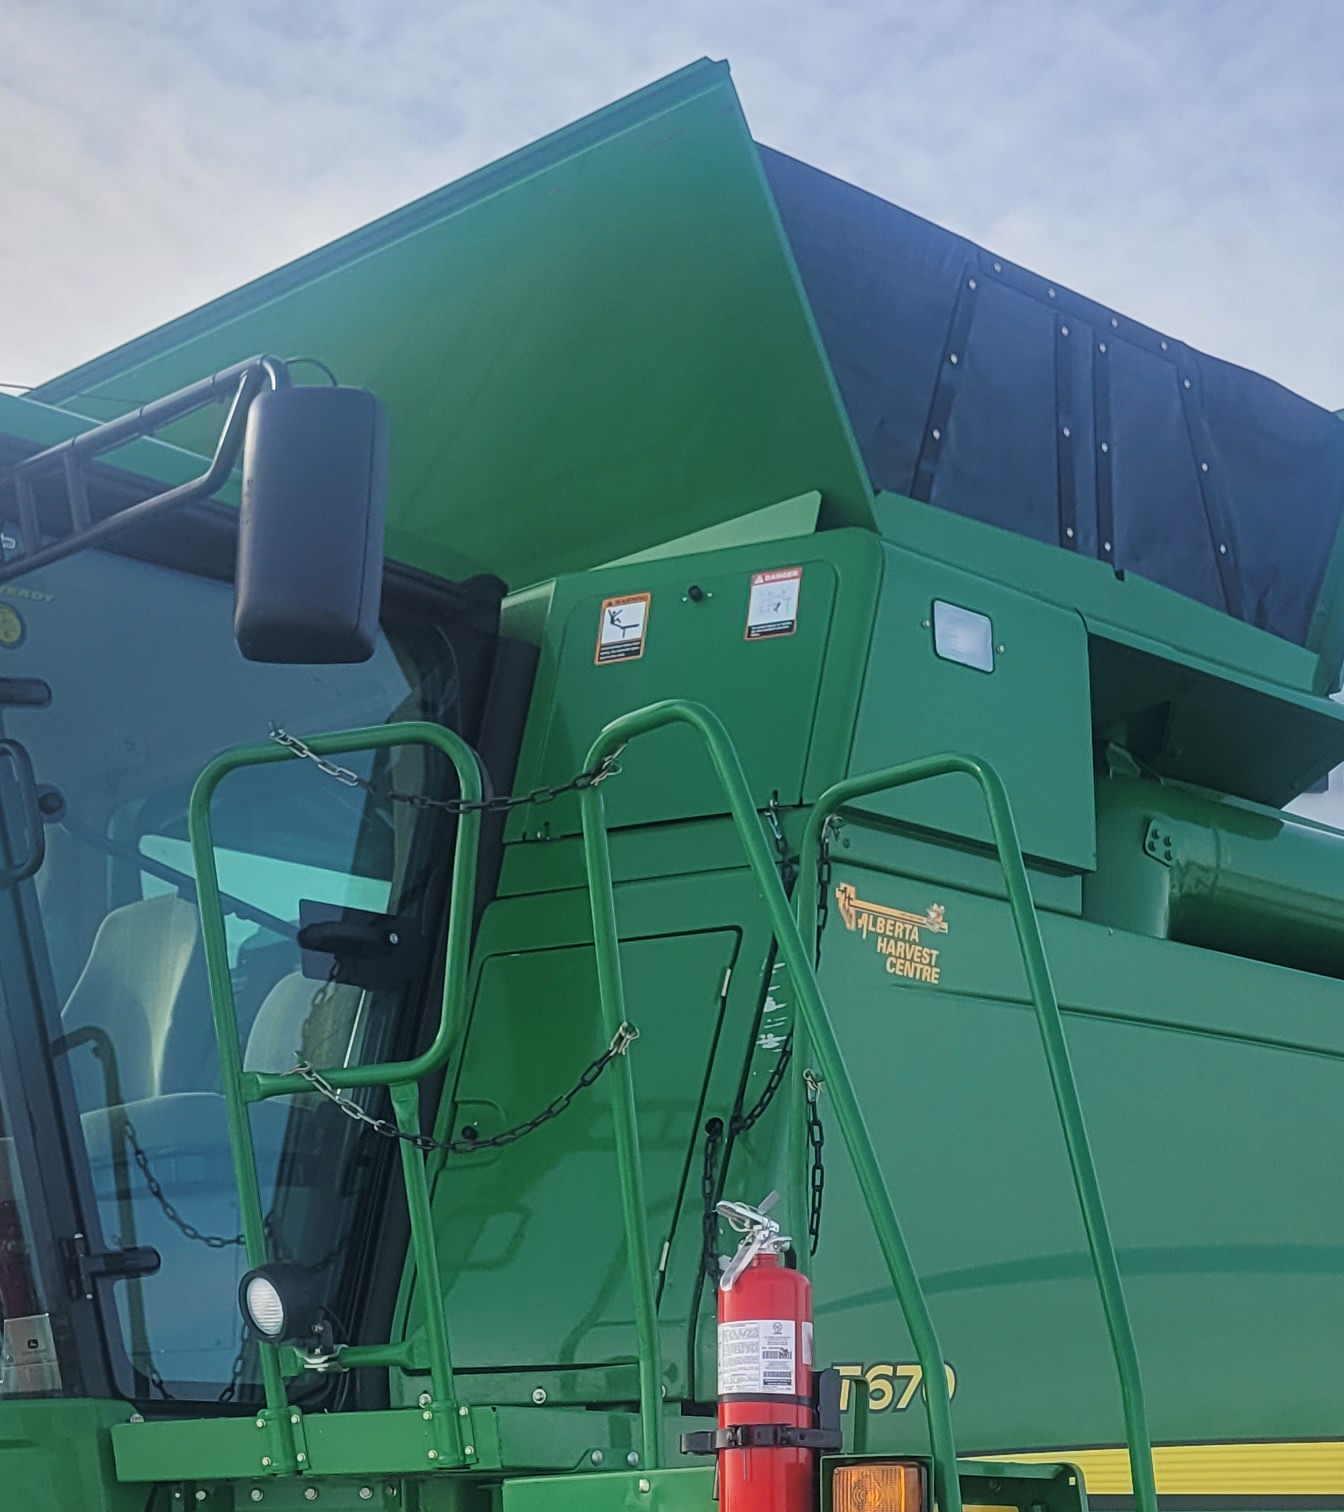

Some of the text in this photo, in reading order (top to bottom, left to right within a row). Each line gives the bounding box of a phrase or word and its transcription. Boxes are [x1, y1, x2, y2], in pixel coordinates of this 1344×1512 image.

[857, 912, 920, 943] ALBERTA
[876, 936, 940, 967] HARVEST
[885, 956, 941, 985] CENTRE
